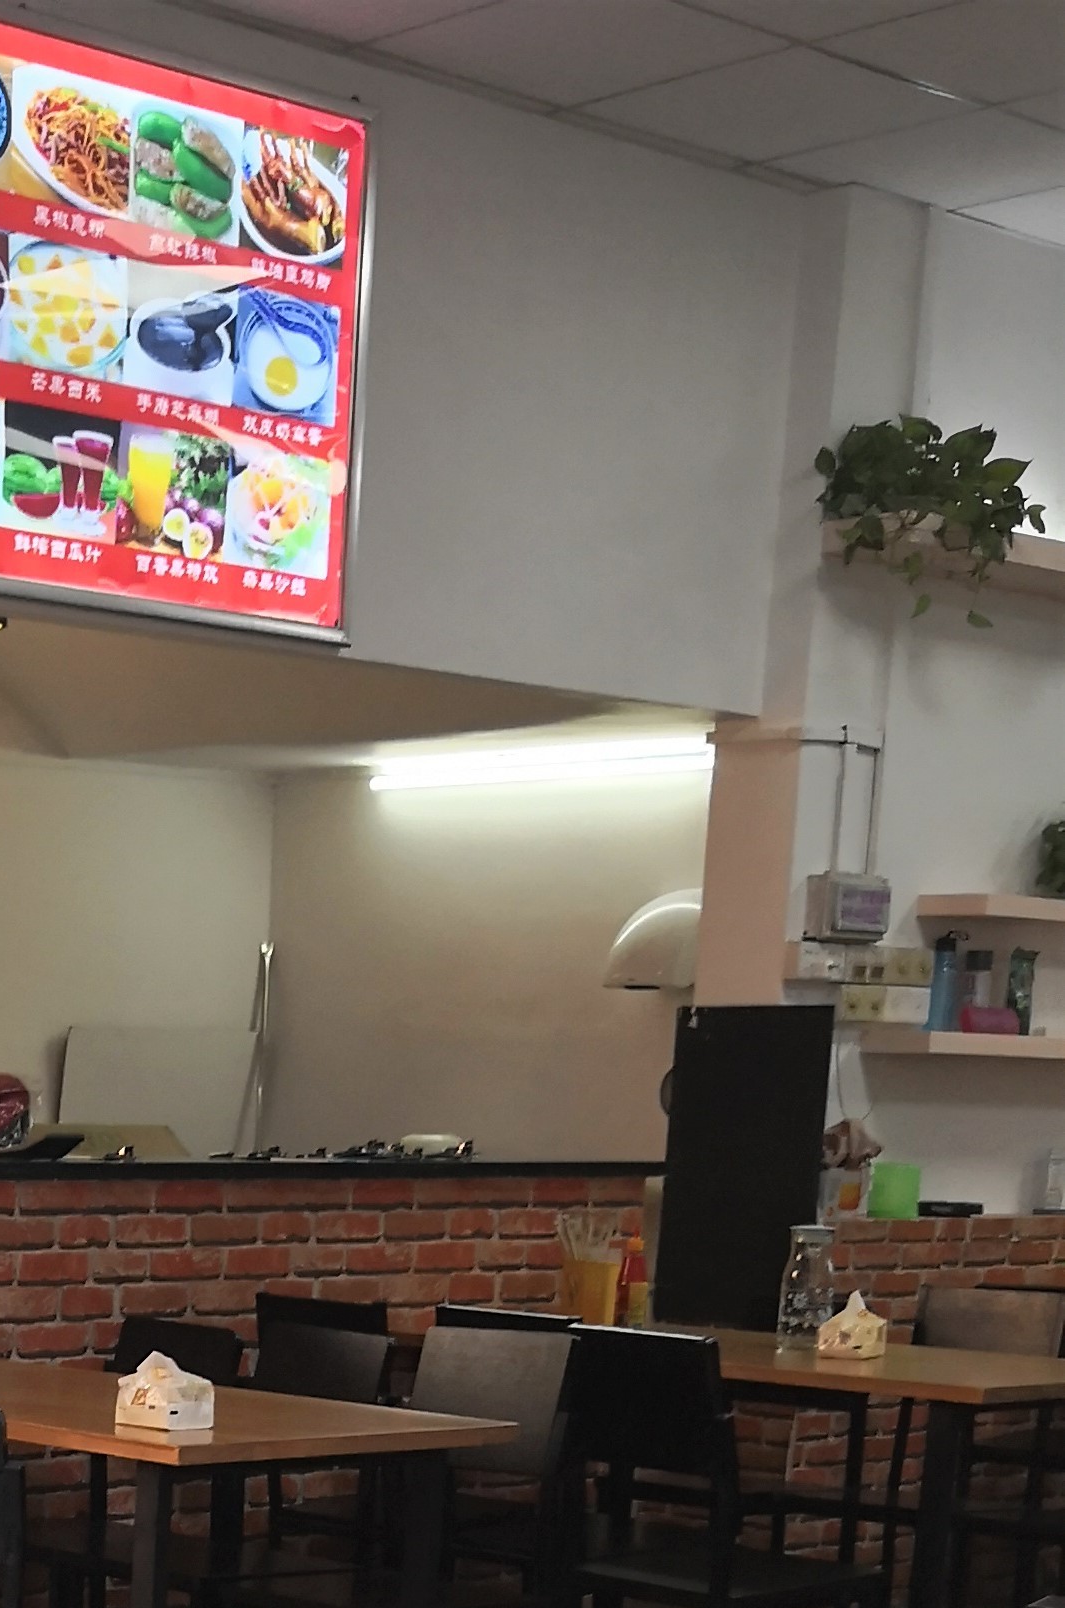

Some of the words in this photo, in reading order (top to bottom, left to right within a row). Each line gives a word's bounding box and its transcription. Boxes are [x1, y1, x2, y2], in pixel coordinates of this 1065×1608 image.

[31, 372, 103, 403] 芒果西米
[14, 534, 102, 564] 鲜榨西瓜汁
